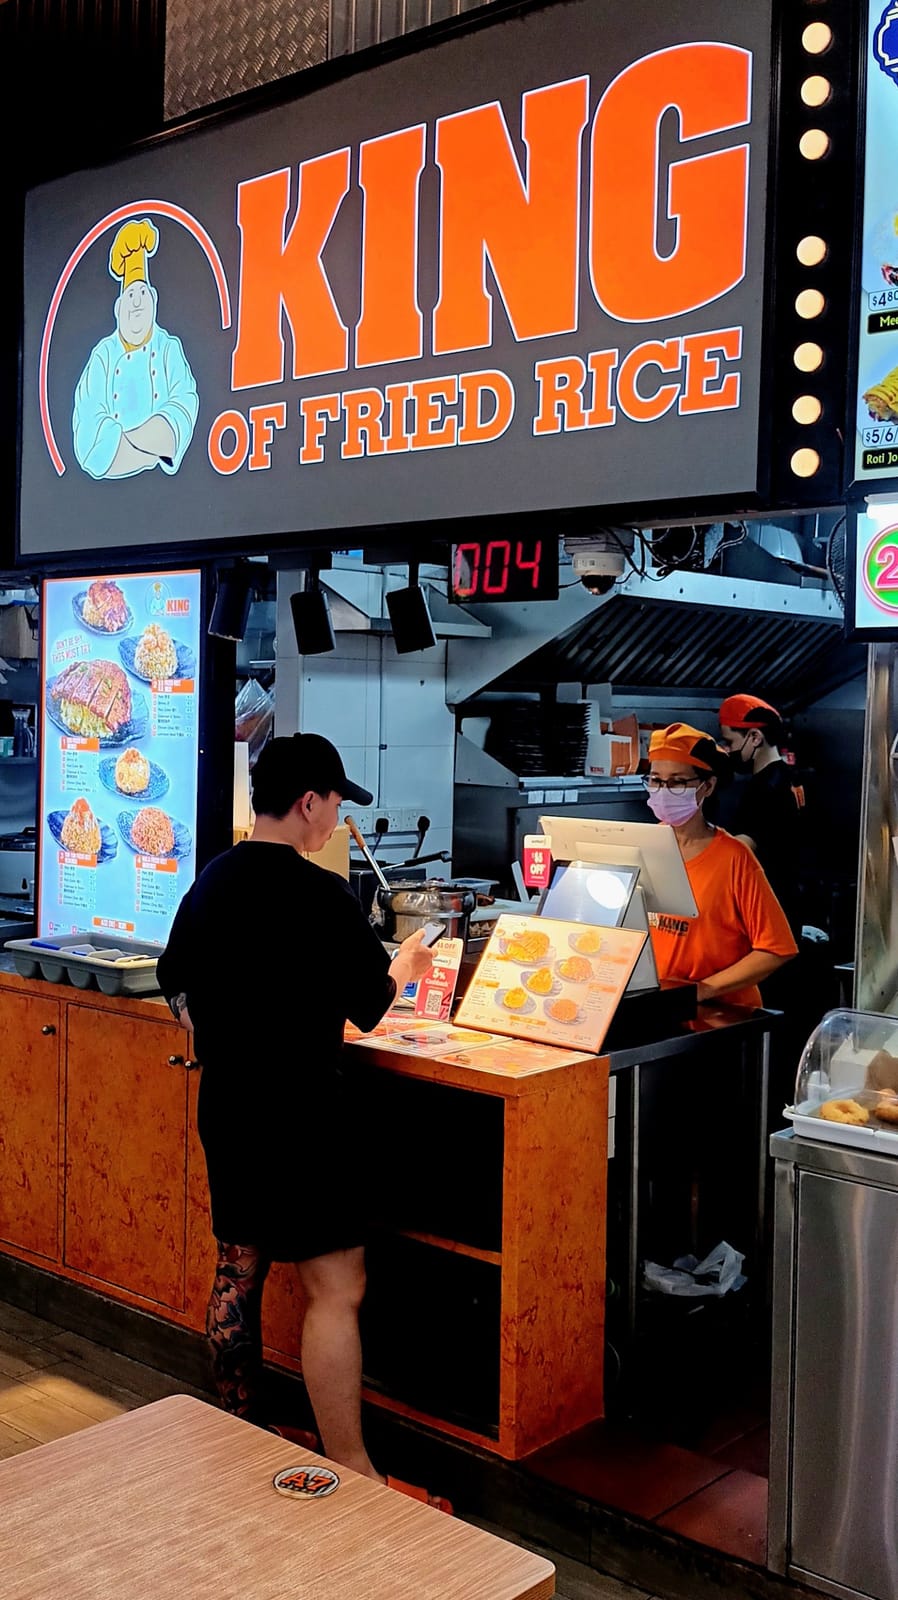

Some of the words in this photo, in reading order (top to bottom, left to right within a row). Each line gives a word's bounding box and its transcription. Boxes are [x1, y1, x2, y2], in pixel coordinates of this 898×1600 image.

[231, 41, 753, 392] KING
[207, 401, 287, 475] OF
[299, 369, 515, 466] FRIED
[532, 326, 743, 436] RICE
[866, 453, 885, 464] Roti
[453, 541, 542, 597] 004
[166, 599, 190, 612] KING
[530, 863, 546, 875] OFF
[659, 915, 689, 932] KING
[432, 967, 446, 980] 5%
[277, 1471, 335, 1494] A7
